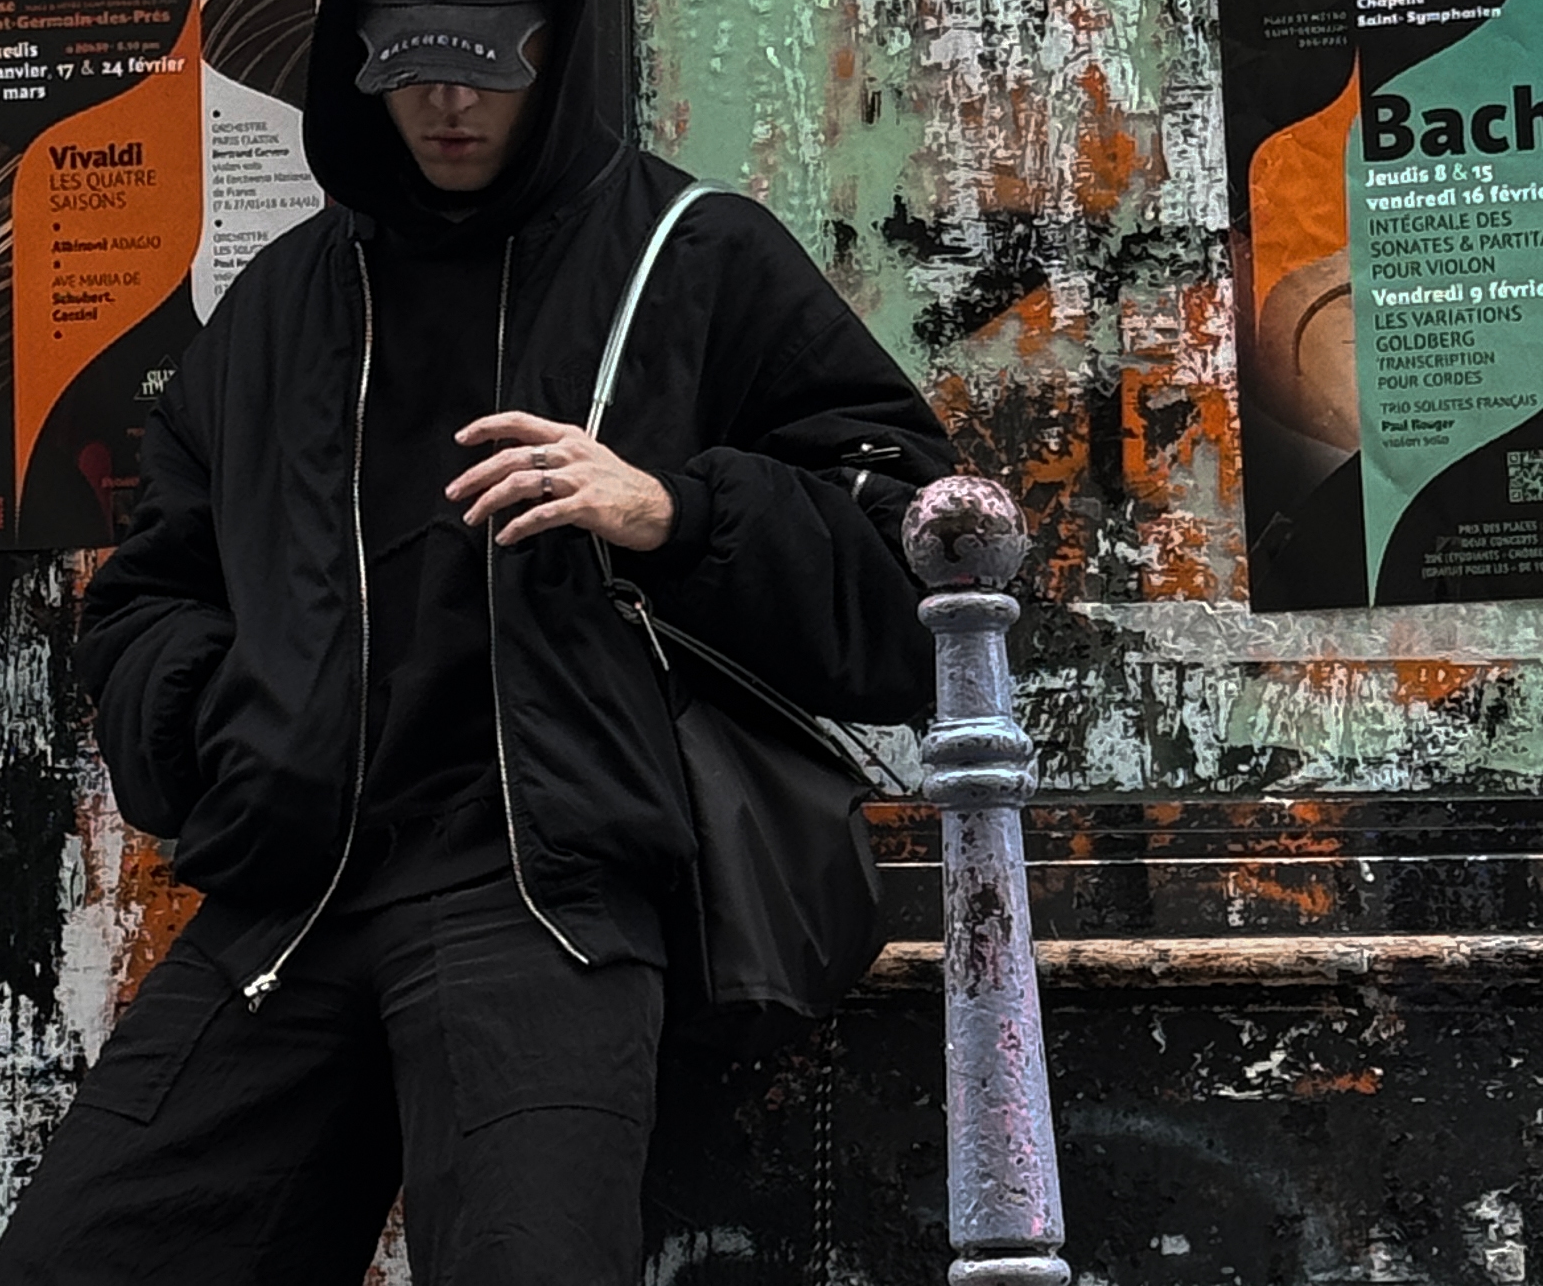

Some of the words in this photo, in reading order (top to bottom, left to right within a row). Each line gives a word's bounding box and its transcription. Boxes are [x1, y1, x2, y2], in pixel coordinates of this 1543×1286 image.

[56, 63, 75, 81] 17
[80, 59, 95, 77] &
[101, 60, 124, 78] 24
[126, 55, 186, 74] février
[3, 85, 46, 102] mars
[1360, 84, 1543, 163] Bach
[48, 142, 144, 171] Vivaldi
[49, 171, 83, 192] LES
[85, 168, 158, 192] QUATRE
[1365, 165, 1429, 187] Jeudis
[1434, 164, 1447, 182] 8
[1451, 162, 1468, 181] &
[1471, 164, 1494, 183] 15
[49, 190, 127, 212] SAISONS
[1365, 187, 1457, 211] vendredi
[1462, 185, 1485, 205] 16
[1369, 211, 1471, 236] INTÉGRALE
[1476, 209, 1514, 229] DES
[110, 234, 162, 251] ADAGIO
[1370, 236, 1455, 258] SONATES
[1459, 234, 1474, 252] &
[1479, 229, 1543, 251] PARTIT
[51, 273, 77, 288] AVE
[122, 271, 142, 286] DE
[1372, 260, 1423, 281] POUR
[1425, 255, 1496, 277] VIOLON
[1371, 283, 1464, 306] Vendredi
[1469, 286, 1483, 304] 9
[1374, 311, 1409, 331] LES
[1411, 304, 1523, 328] VARIATIONS
[1375, 330, 1475, 352] GOLDBERG
[1377, 351, 1496, 371] TRANSCRIPTION
[1377, 374, 1420, 390] POUR
[1423, 370, 1484, 388] CORDES
[1379, 400, 1412, 415] TRIO
[1413, 397, 1474, 413] SOLISTES
[1476, 393, 1538, 410] FRANÇAIS
